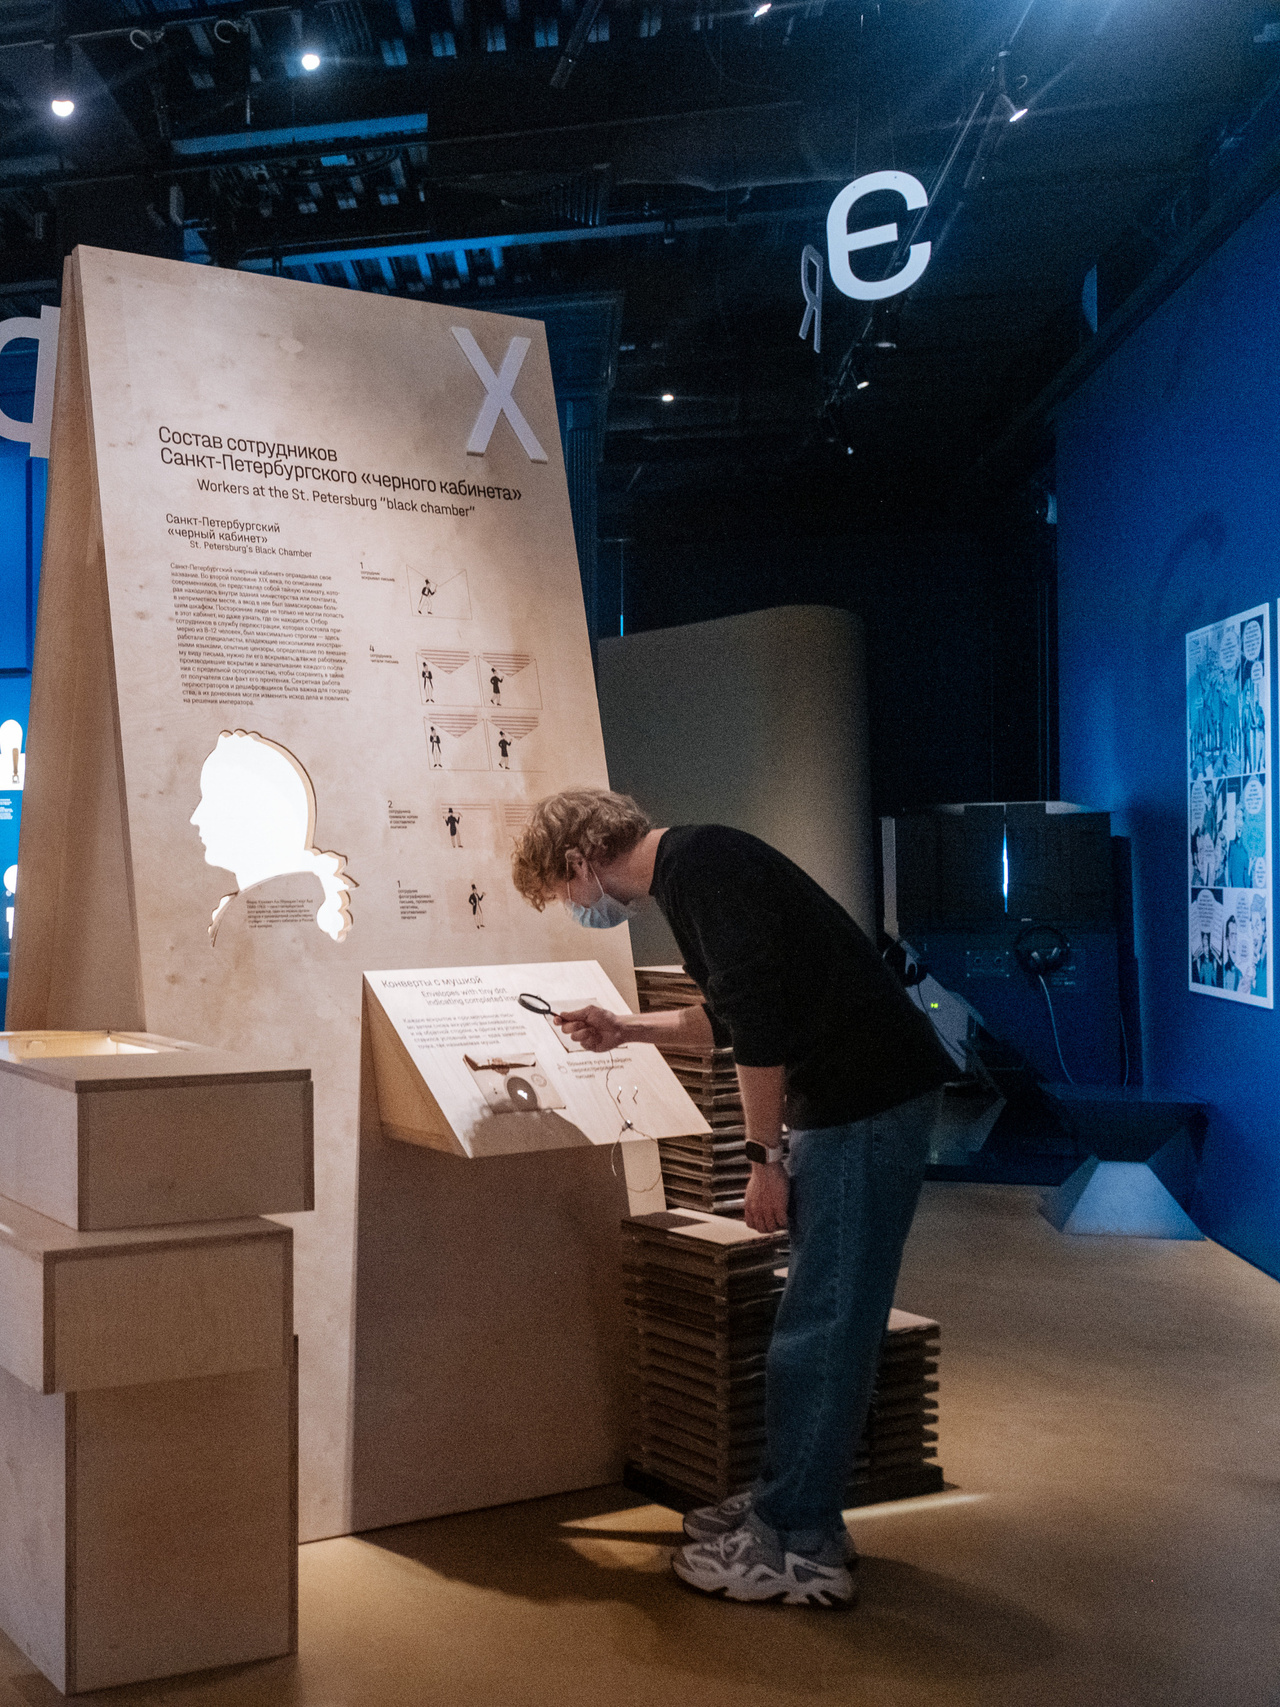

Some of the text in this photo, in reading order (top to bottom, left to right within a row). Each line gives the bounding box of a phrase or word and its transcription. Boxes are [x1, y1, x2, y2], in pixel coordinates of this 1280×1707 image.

[158, 426, 337, 461] Состав сотрудников
[160, 447, 521, 500] Санкт-Петербургского «черного кабинета»
[196, 478, 249, 495] Workers
[252, 485, 265, 496] at
[268, 486, 288, 499] the
[291, 488, 308, 501] St.
[312, 490, 377, 510] Petersburg
[165, 513, 280, 532] Санкт-Петербургский
[167, 528, 267, 543] «черный кабинет»
[188, 540, 312, 557] St. Petersburg's Black Chamber
